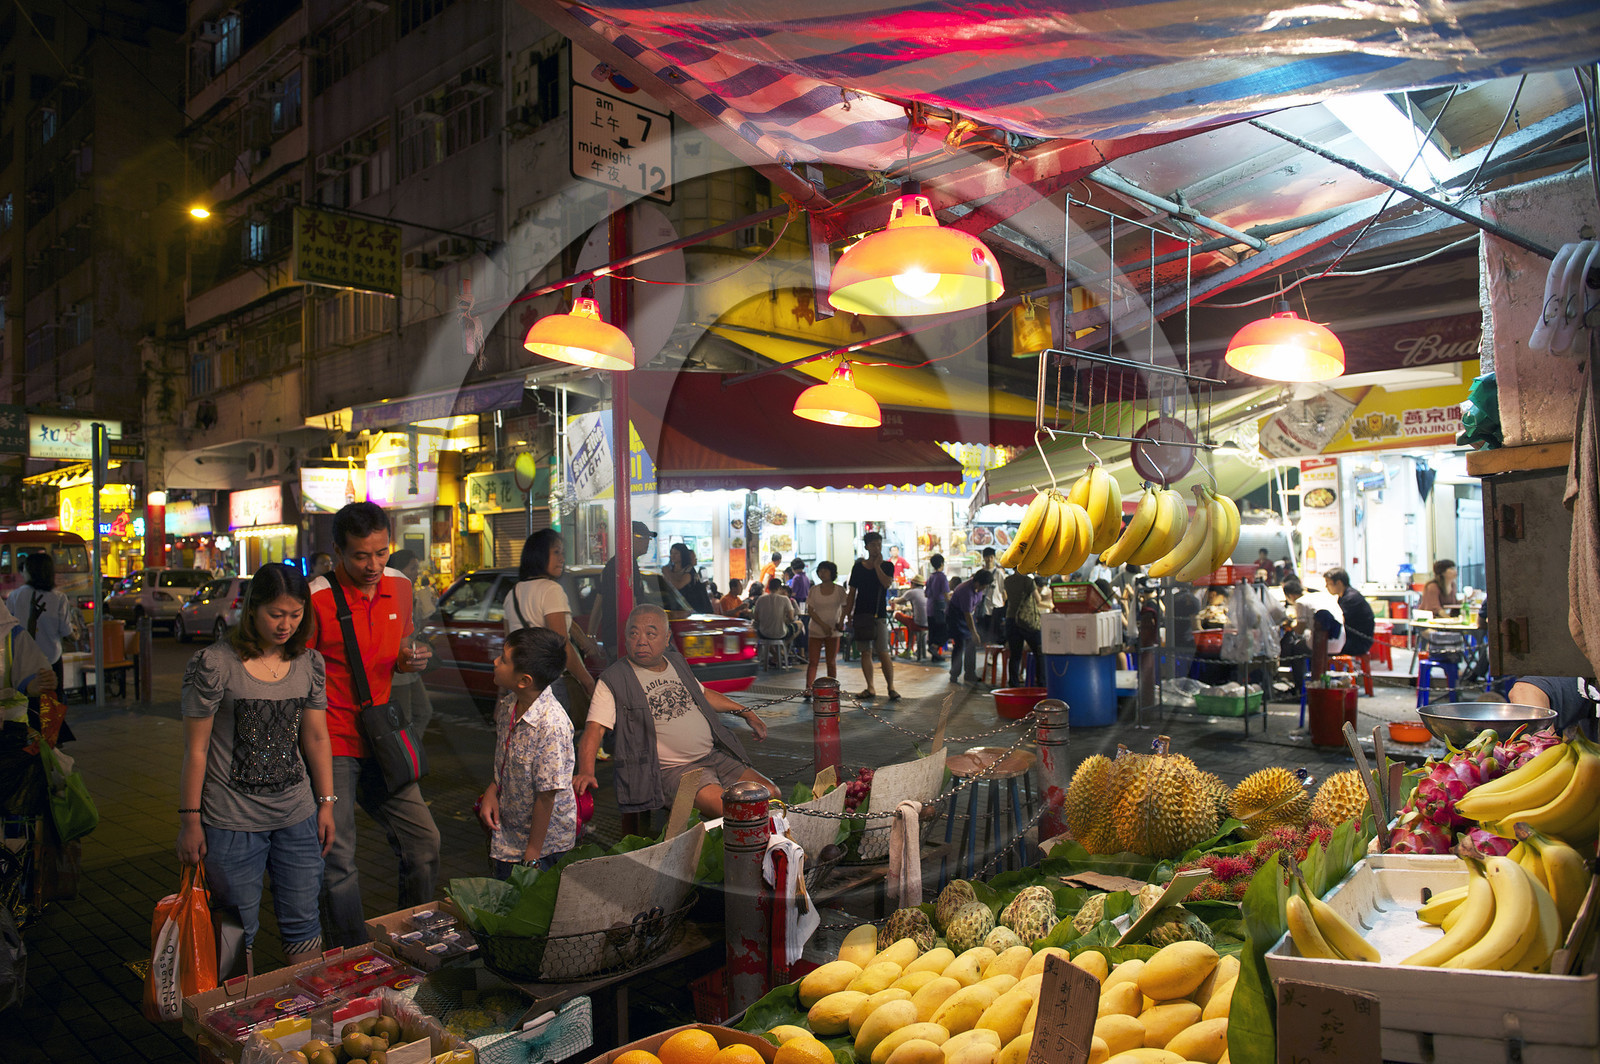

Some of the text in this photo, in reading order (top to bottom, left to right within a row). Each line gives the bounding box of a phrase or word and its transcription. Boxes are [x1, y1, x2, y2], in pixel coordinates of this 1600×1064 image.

[596, 97, 614, 112] am
[590, 111, 620, 133] 上午
[636, 114, 652, 142] 7
[578, 141, 632, 166] midnight
[590, 159, 620, 183] 午夜
[638, 162, 666, 196] 12
[302, 212, 398, 257] 永昌公寓
[1404, 423, 1454, 435] YANJING
[579, 444, 606, 489] LIGHT
